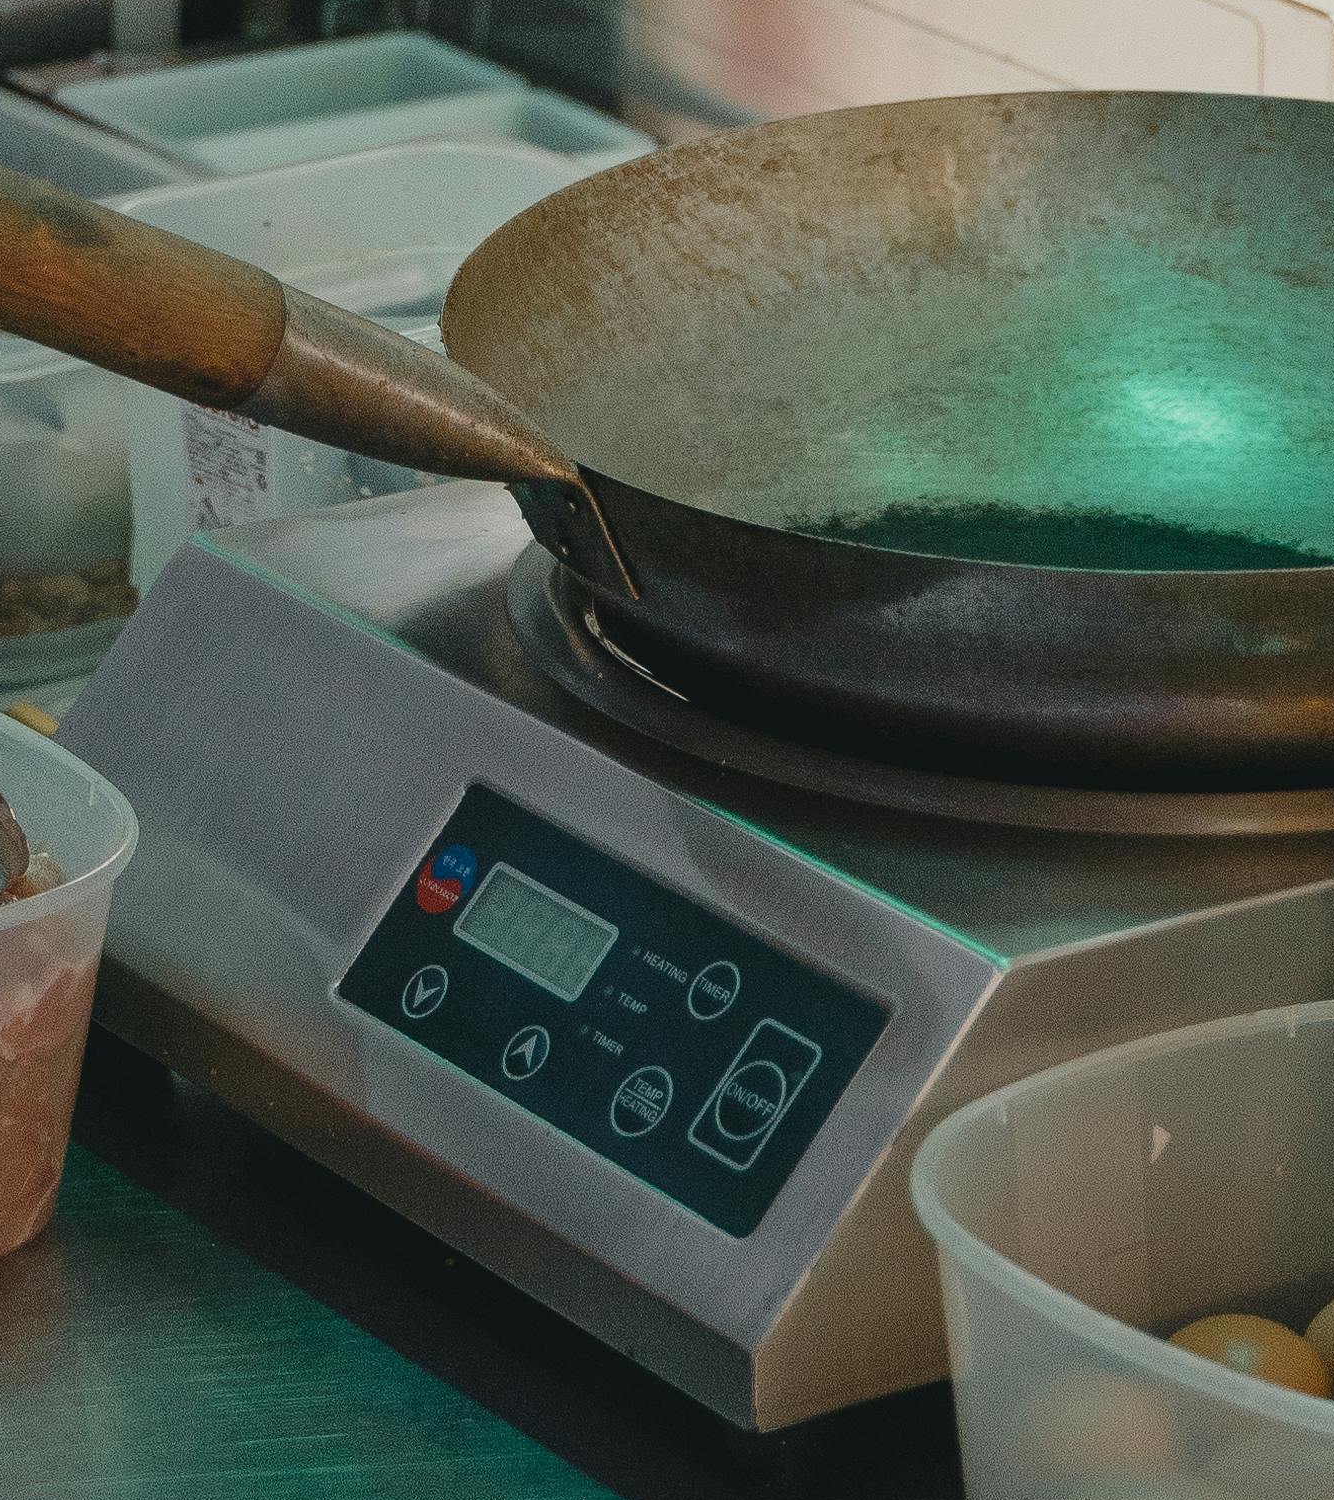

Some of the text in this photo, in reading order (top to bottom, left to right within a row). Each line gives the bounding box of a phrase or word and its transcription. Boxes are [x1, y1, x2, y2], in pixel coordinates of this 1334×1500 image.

[642, 951, 689, 984] HEATING
[618, 992, 648, 1015] TEMP
[699, 976, 731, 1004] TIMER
[592, 1030, 624, 1056] TIMER
[633, 1077, 664, 1102] TEMP
[725, 1082, 777, 1116] ON/OFF
[619, 1094, 658, 1123] HEATING
